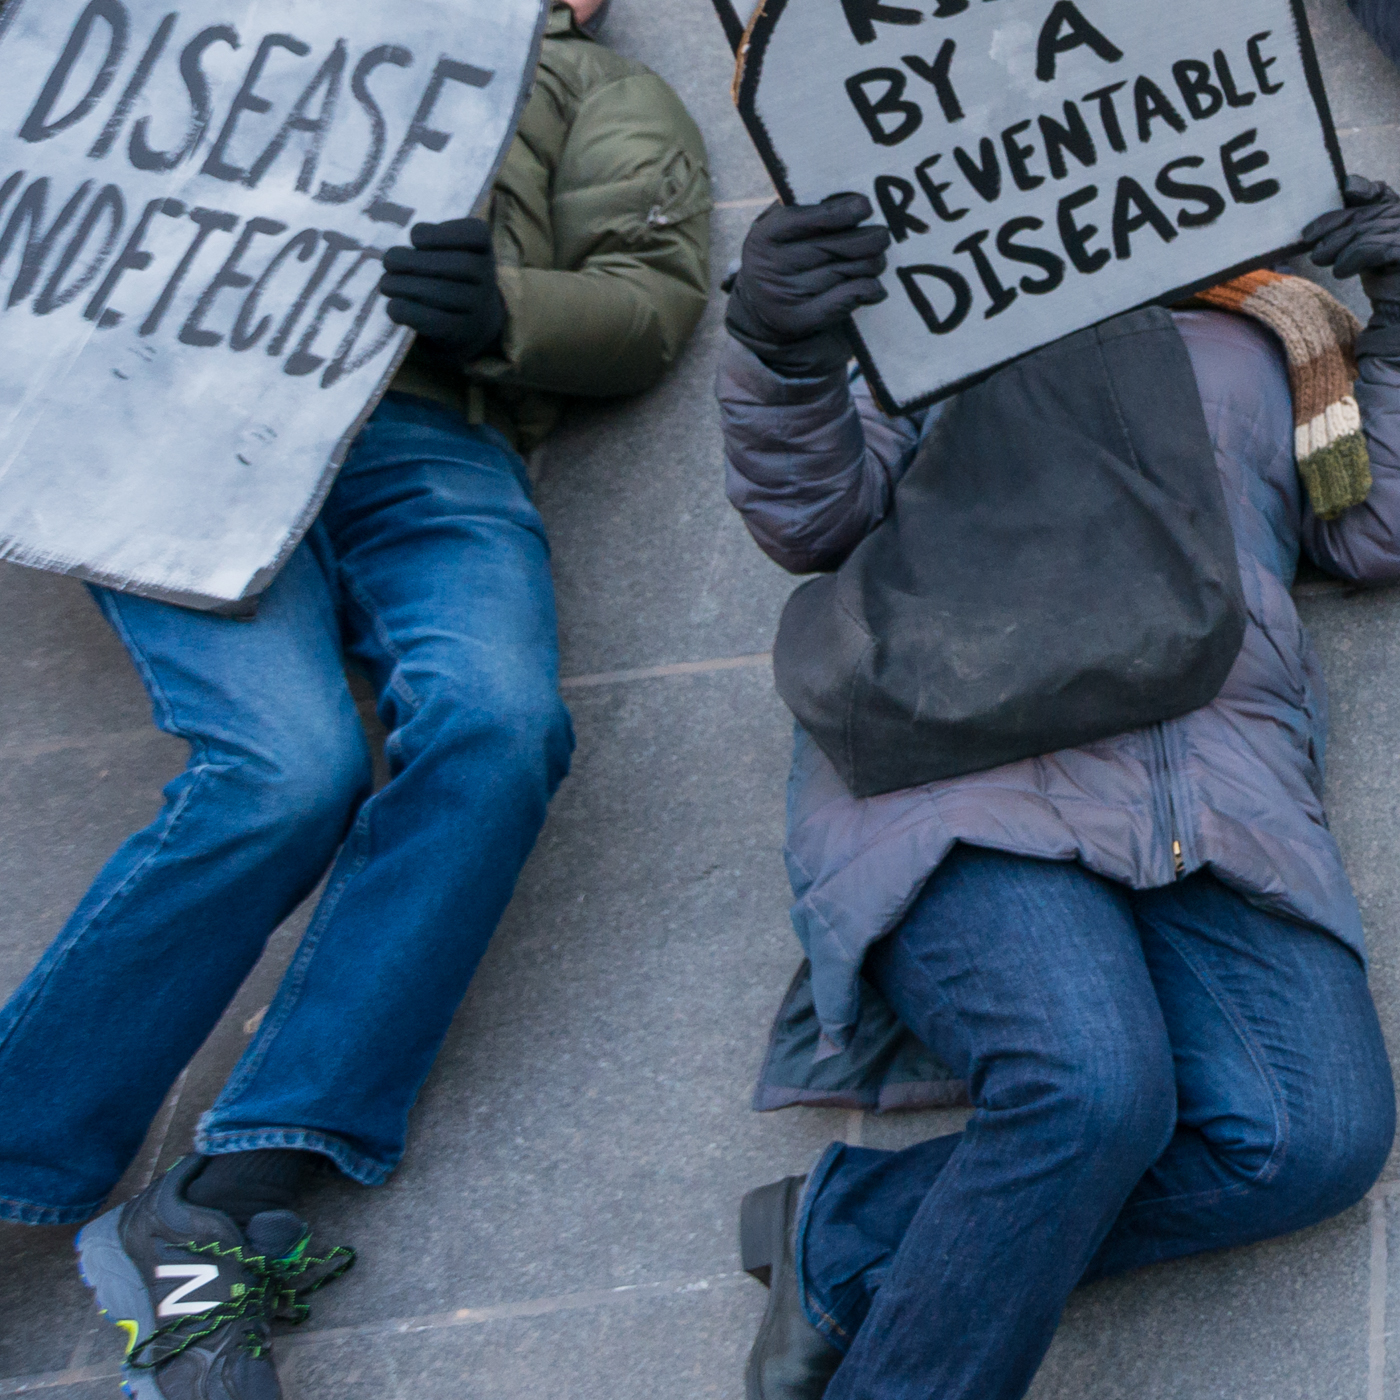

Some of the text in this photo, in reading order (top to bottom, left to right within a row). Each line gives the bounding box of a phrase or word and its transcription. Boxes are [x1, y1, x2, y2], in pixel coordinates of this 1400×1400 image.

[844, 0, 1124, 146] BY A
[874, 31, 1284, 244] REVENTABLE
[0, 170, 404, 389] NDETECTED
[896, 128, 1281, 335] DISEASE
